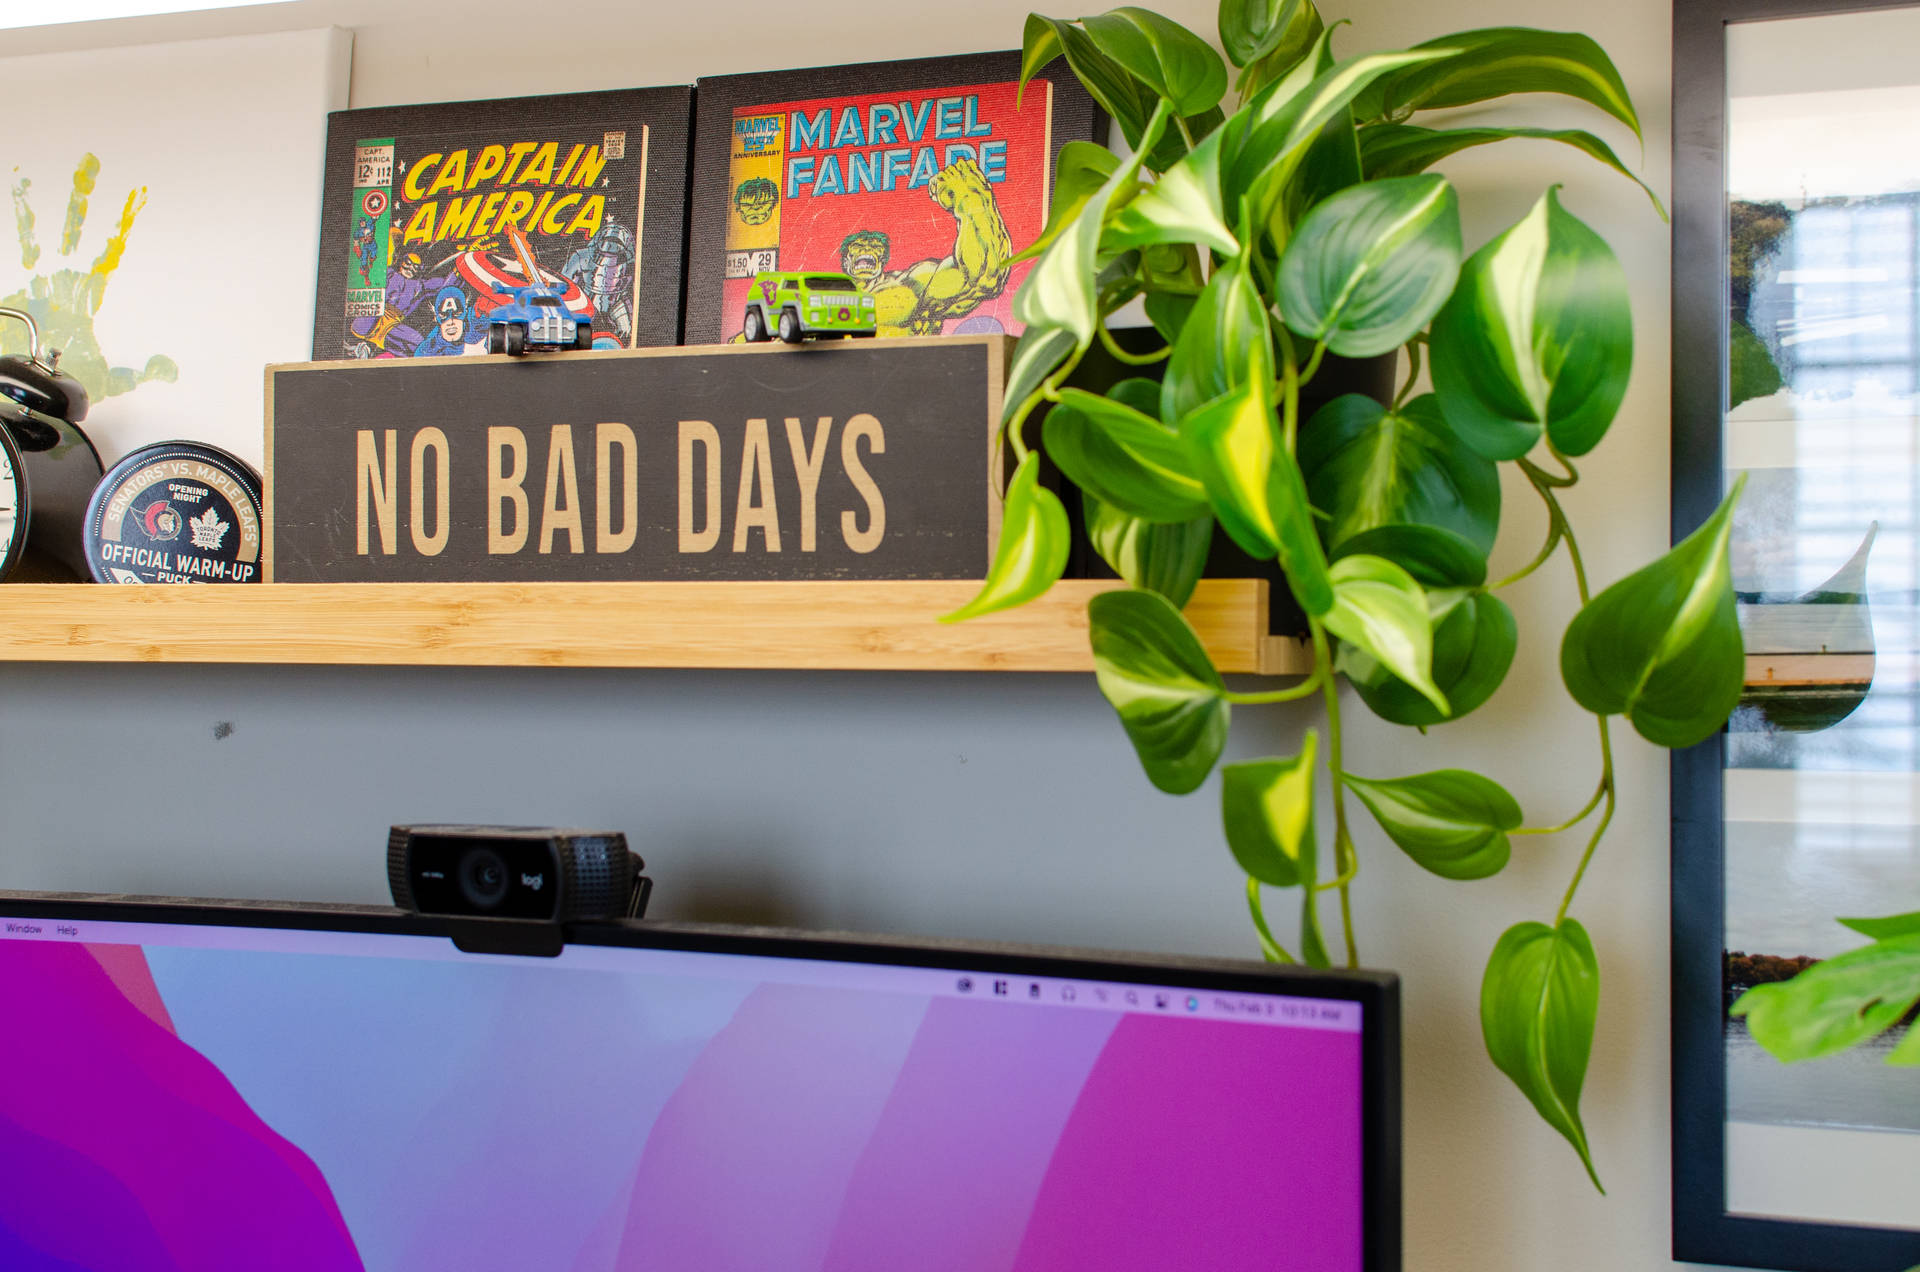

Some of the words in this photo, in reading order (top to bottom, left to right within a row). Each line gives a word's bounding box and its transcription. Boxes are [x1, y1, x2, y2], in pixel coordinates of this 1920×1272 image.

[735, 116, 781, 133] MARVEL
[788, 94, 992, 153] MARVEL
[734, 150, 781, 159] ANNIVERSARY
[377, 166, 391, 177] 112
[401, 141, 609, 202] CAPTAIN
[401, 190, 606, 246] AMERICA
[727, 257, 748, 269] $1.50
[758, 253, 772, 266] 29
[347, 290, 383, 303] MARVEL
[168, 483, 209, 497] OPENING
[357, 426, 450, 557] NO
[488, 422, 638, 555] BAD
[678, 413, 886, 554] DAYS
[109, 465, 164, 523] SENATORS
[171, 463, 193, 476] VS.
[196, 465, 241, 500] MAPLE
[234, 498, 258, 543] LEAFS
[173, 492, 202, 504] NIGHT
[101, 543, 172, 571] OFFICIAL
[176, 554, 255, 583] WARM-UP
[157, 571, 192, 584] PUCK
[521, 872, 543, 891] logi
[6, 923, 43, 934] Window
[57, 925, 79, 936] Help
